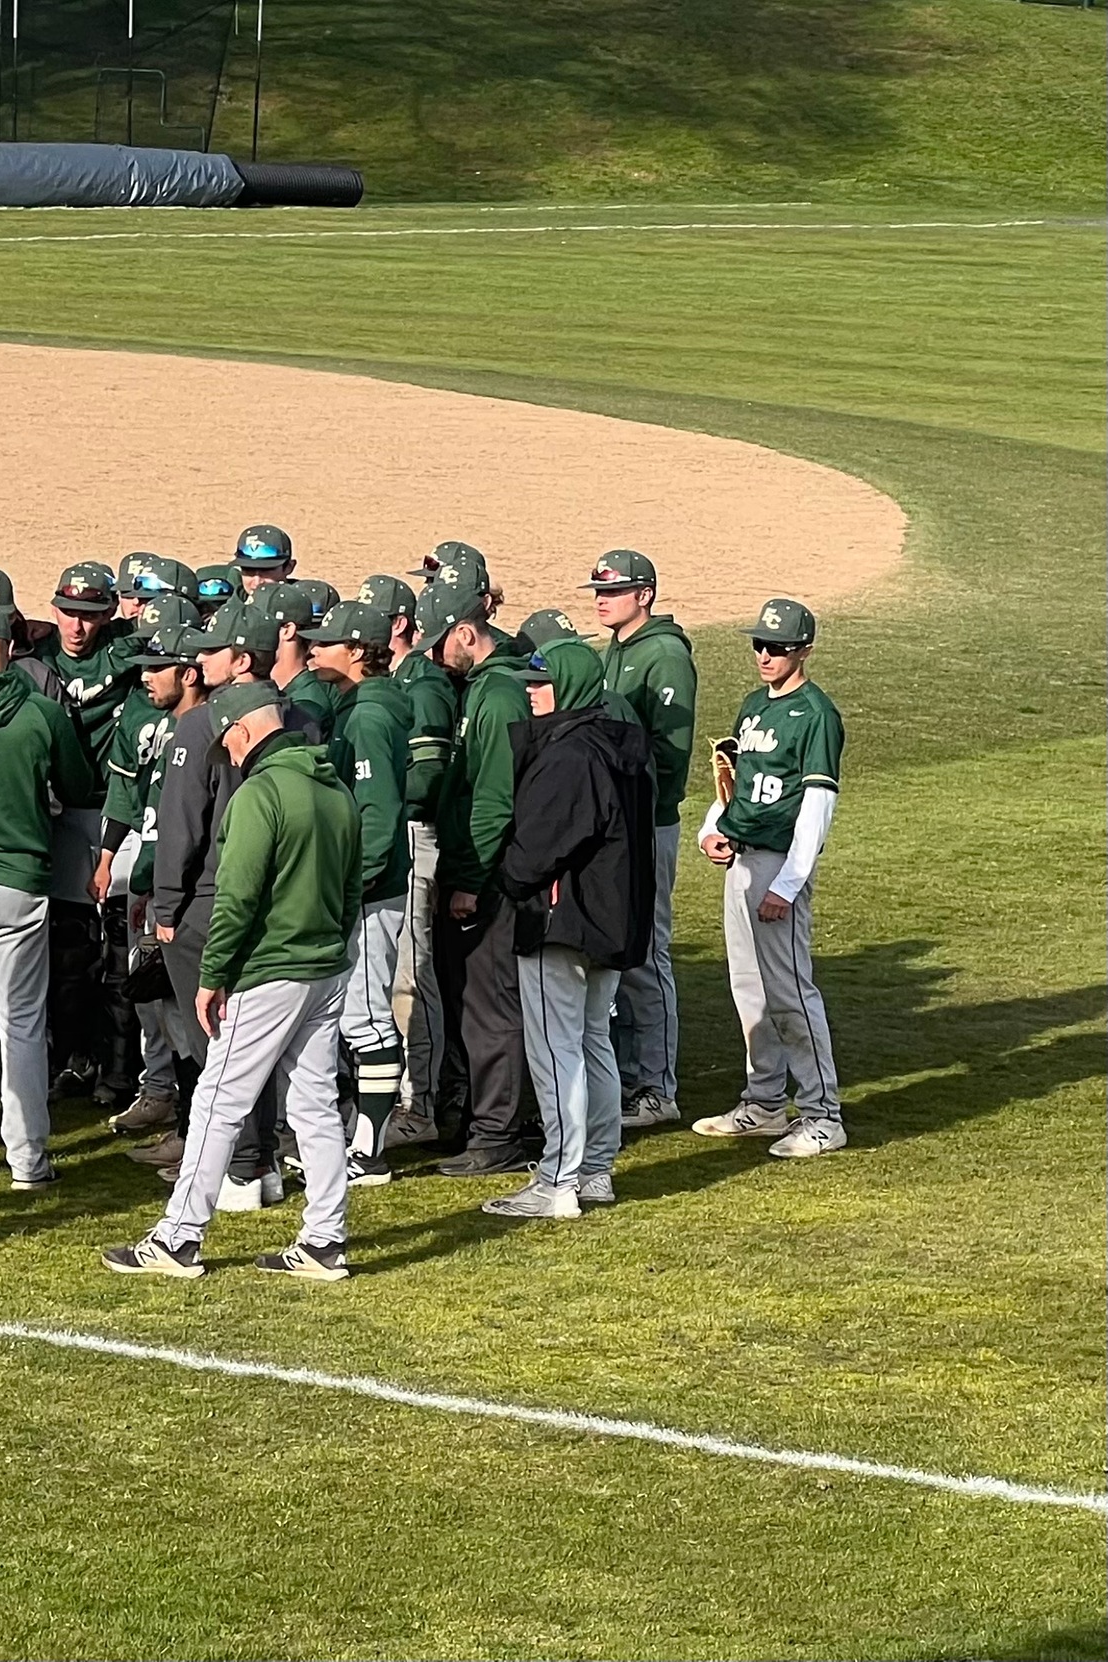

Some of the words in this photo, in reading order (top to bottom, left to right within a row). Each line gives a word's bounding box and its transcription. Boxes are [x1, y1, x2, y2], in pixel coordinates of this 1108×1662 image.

[142, 604, 160, 623] EC
[762, 607, 781, 629] EC
[662, 687, 675, 706] 7
[172, 747, 187, 767] 13
[355, 759, 372, 780] 31
[751, 772, 783, 805] 19
[398, 1122, 418, 1138] N
[140, 1247, 159, 1265] N
[286, 1250, 305, 1269] N
